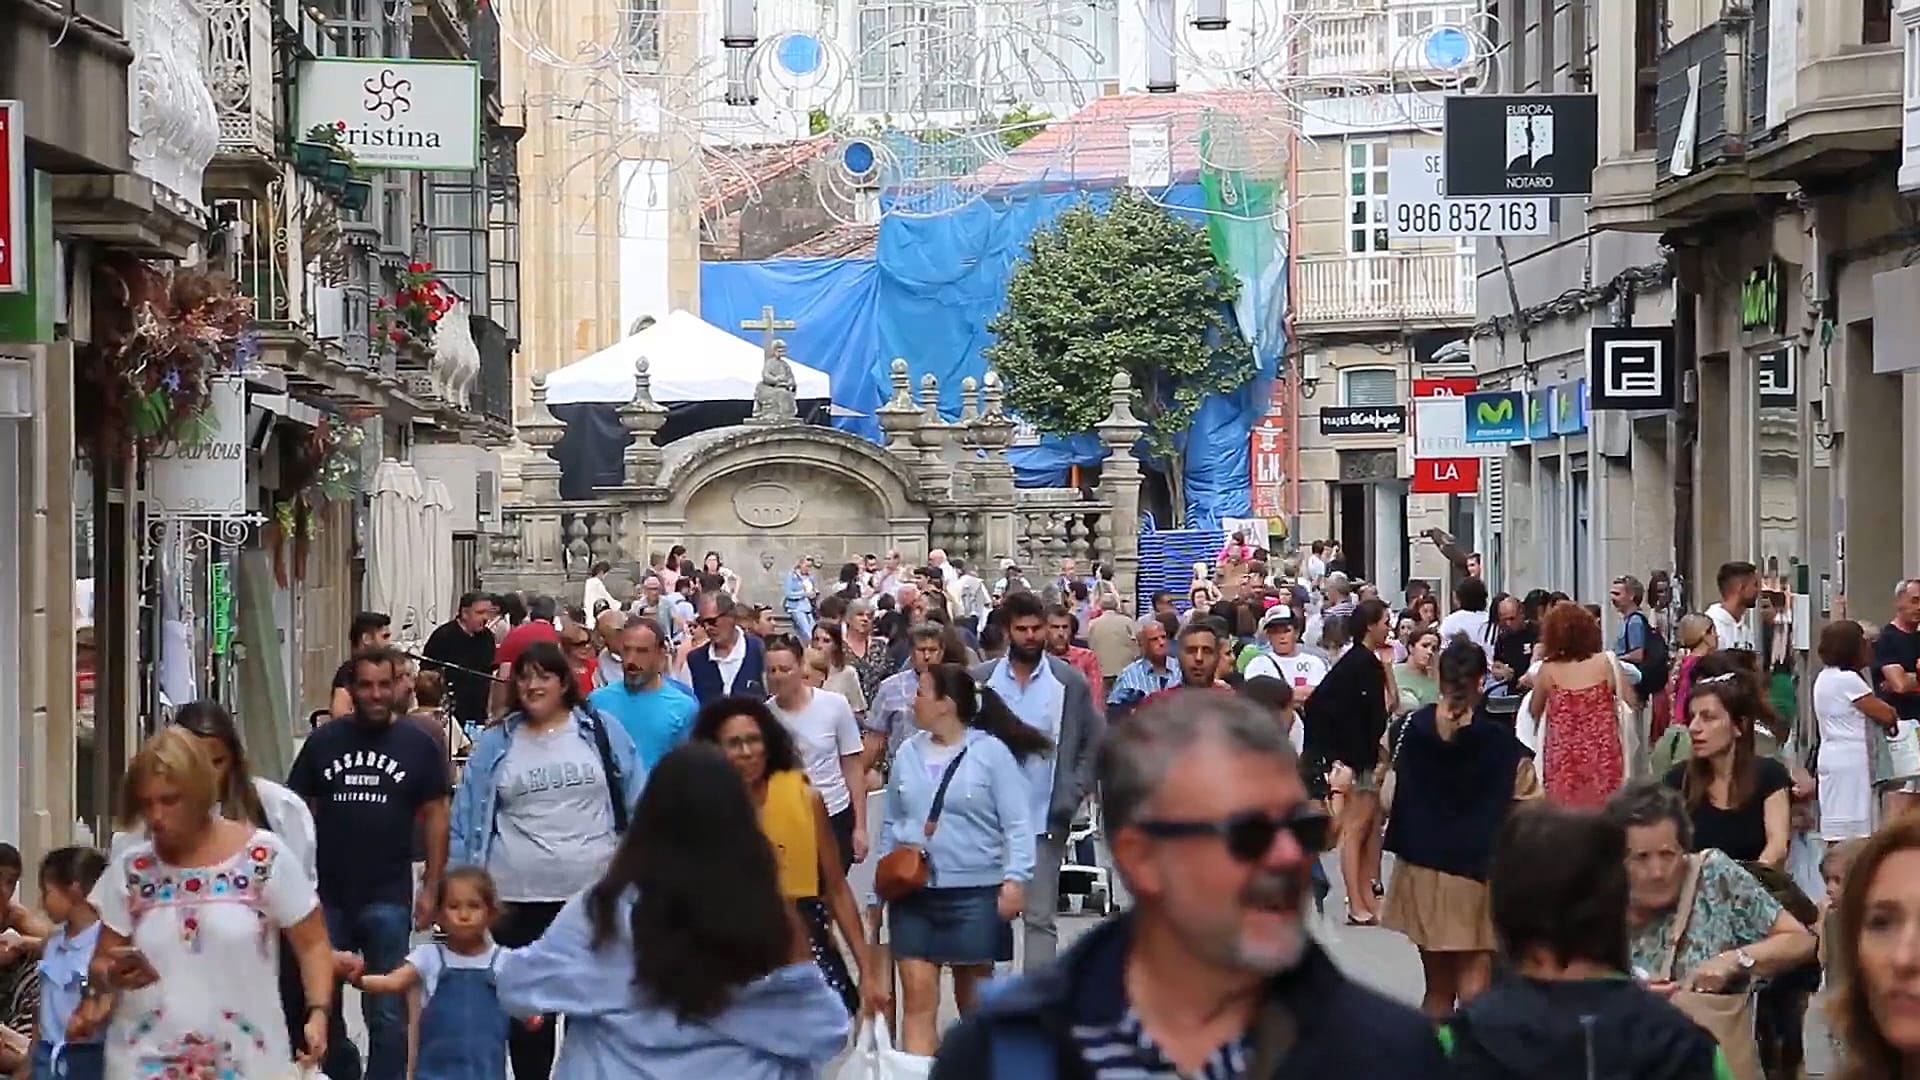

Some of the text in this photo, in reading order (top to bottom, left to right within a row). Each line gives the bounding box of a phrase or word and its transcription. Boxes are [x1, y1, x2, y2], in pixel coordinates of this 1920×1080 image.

[1506, 105, 1554, 115] EUROPA
[1506, 176, 1554, 189] NOTARIO
[1398, 202, 1537, 232] 986 852 163
[1434, 463, 1459, 480] LA
[324, 751, 406, 784] PASADENA
